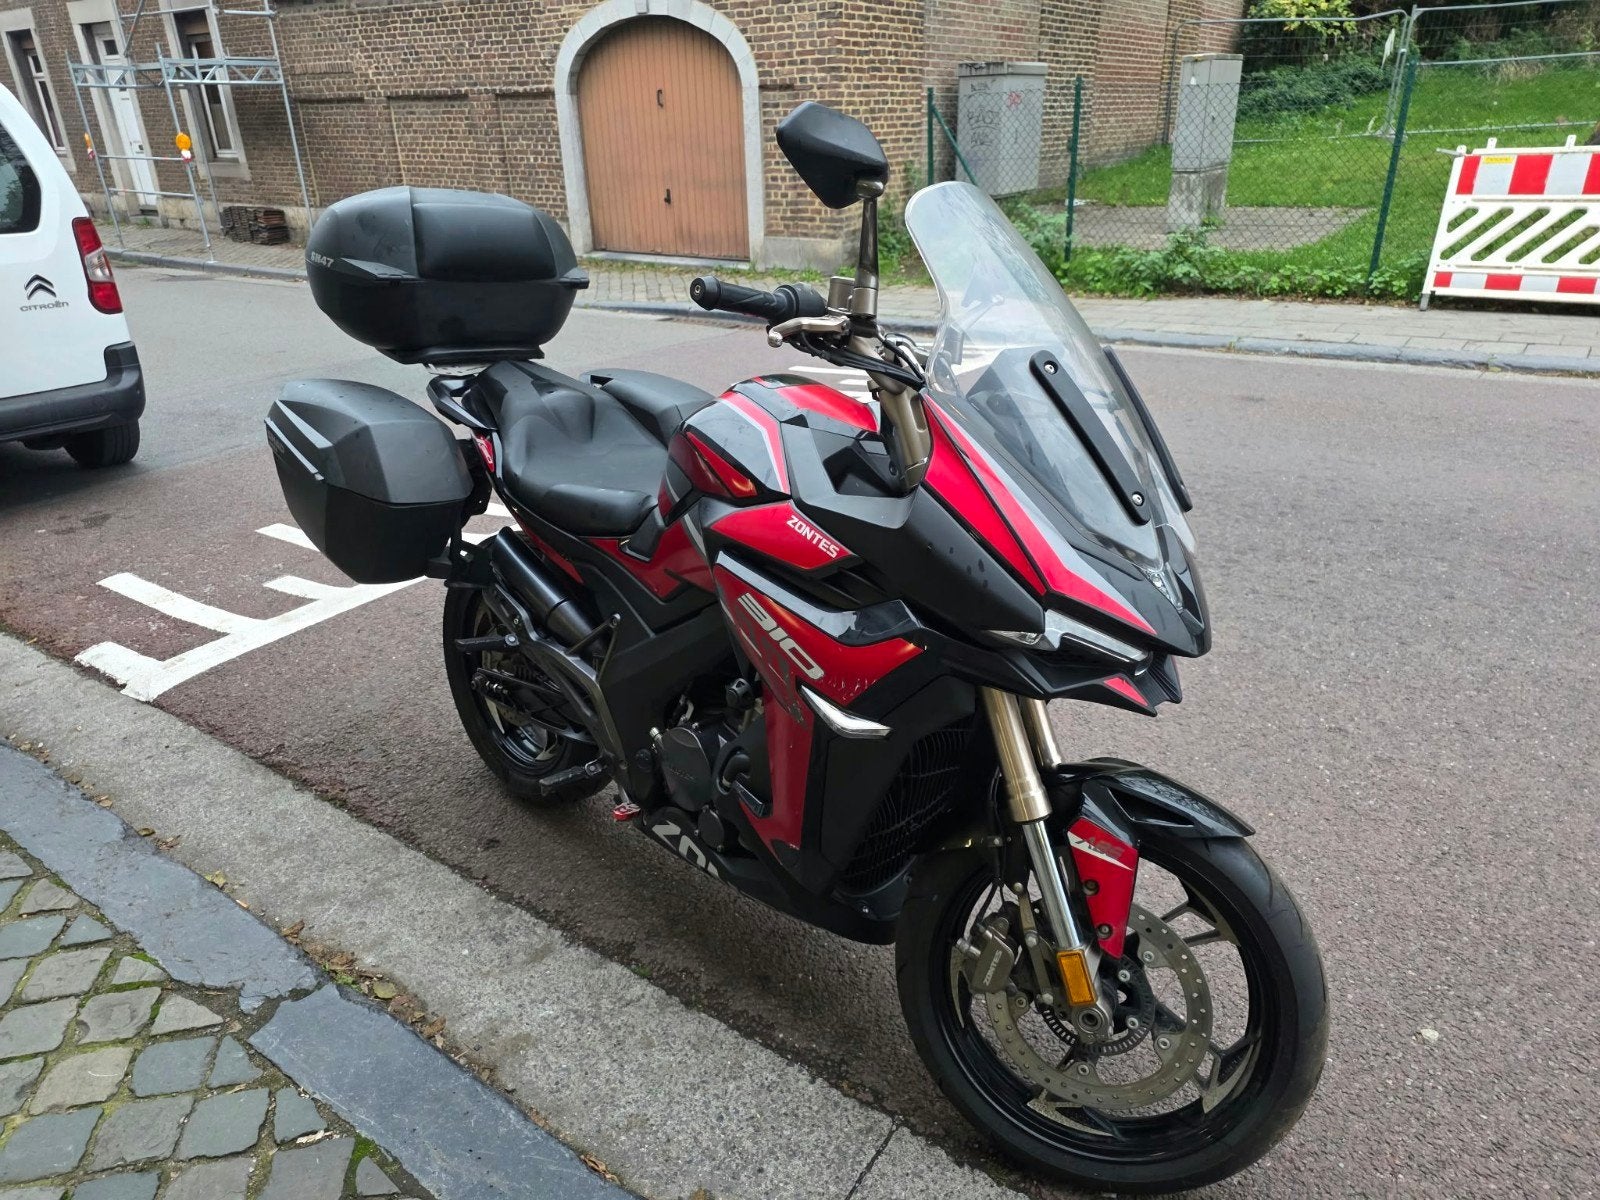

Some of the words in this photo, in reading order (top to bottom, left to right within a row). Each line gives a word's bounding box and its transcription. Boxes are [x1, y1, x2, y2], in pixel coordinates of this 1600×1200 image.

[786, 515, 840, 558] ZONTES
[738, 592, 825, 680] 310
[652, 820, 719, 878] ZO
[982, 949, 1002, 986] ZONTES
